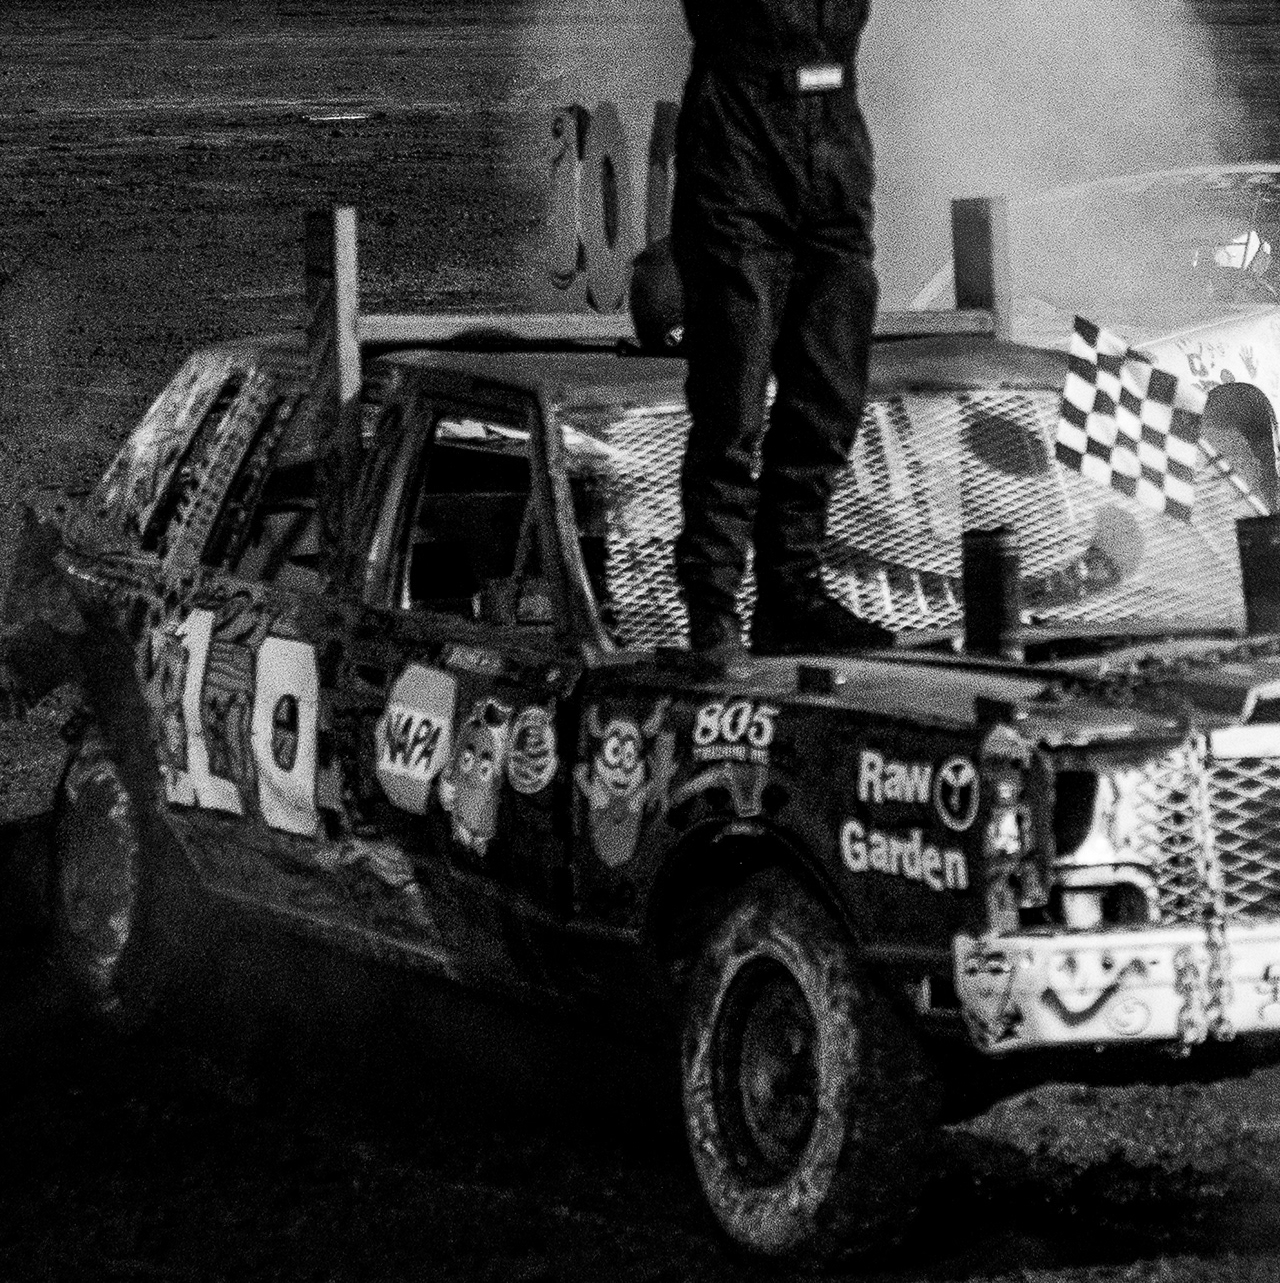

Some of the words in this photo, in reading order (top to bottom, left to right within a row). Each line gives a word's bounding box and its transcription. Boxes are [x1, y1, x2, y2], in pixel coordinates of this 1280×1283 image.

[165, 608, 319, 837] 10
[693, 701, 780, 747] 805
[857, 749, 933, 804] Raw
[839, 819, 970, 891] Garden
